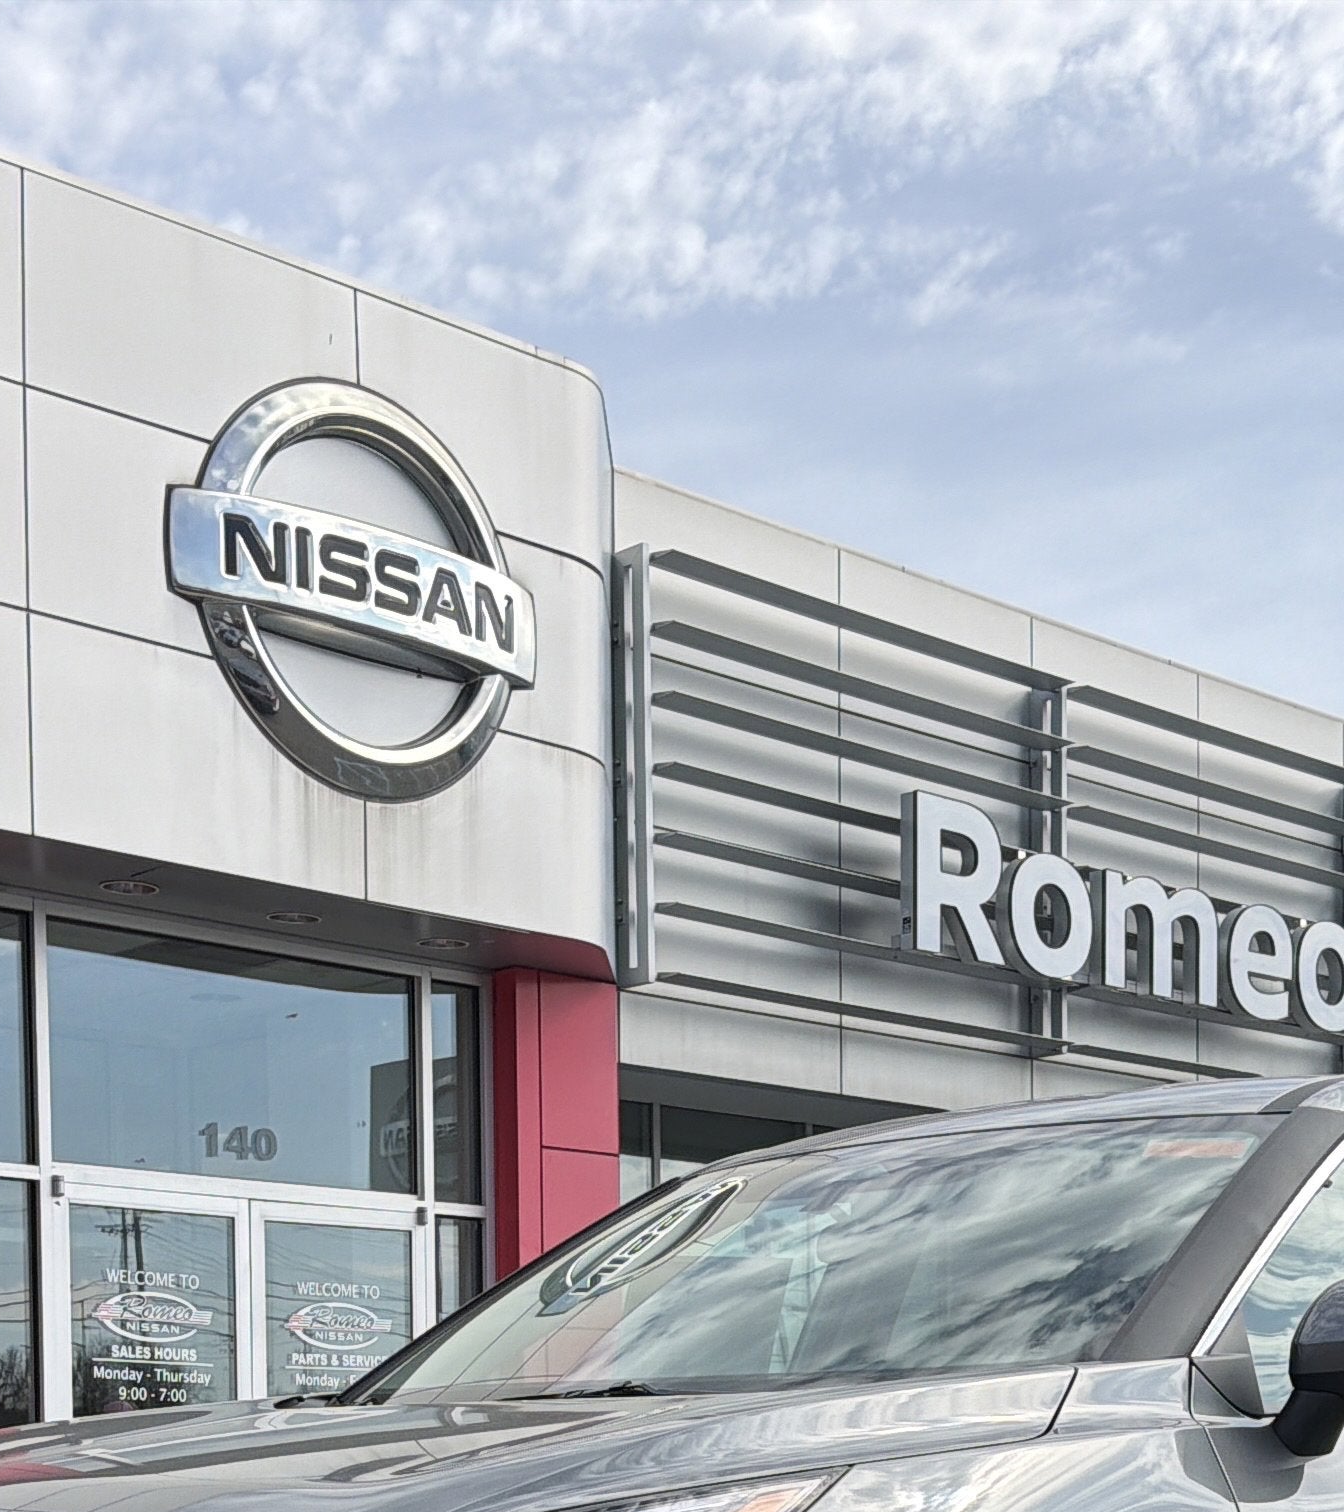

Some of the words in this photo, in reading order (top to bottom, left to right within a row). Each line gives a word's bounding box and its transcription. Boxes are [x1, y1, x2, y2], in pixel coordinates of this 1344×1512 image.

[221, 511, 514, 655] NISSAN
[198, 1121, 278, 1162] 140
[106, 1268, 176, 1288] WELCOME
[179, 1274, 200, 1290] TO
[297, 1281, 360, 1298] WELCOME
[361, 1285, 380, 1299] TO
[119, 1294, 194, 1320] Romeo
[126, 1322, 180, 1334] NISSAN
[315, 1331, 364, 1342] NISSAN
[111, 1345, 152, 1359] SALES
[154, 1347, 197, 1361] HOURS
[292, 1353, 328, 1366] PARTS
[330, 1354, 340, 1367] &
[93, 1366, 144, 1383] Monday
[154, 1369, 212, 1387] Thursday
[295, 1373, 340, 1390] Monday
[118, 1387, 148, 1401] 9:00
[158, 1389, 187, 1403] 7:00
